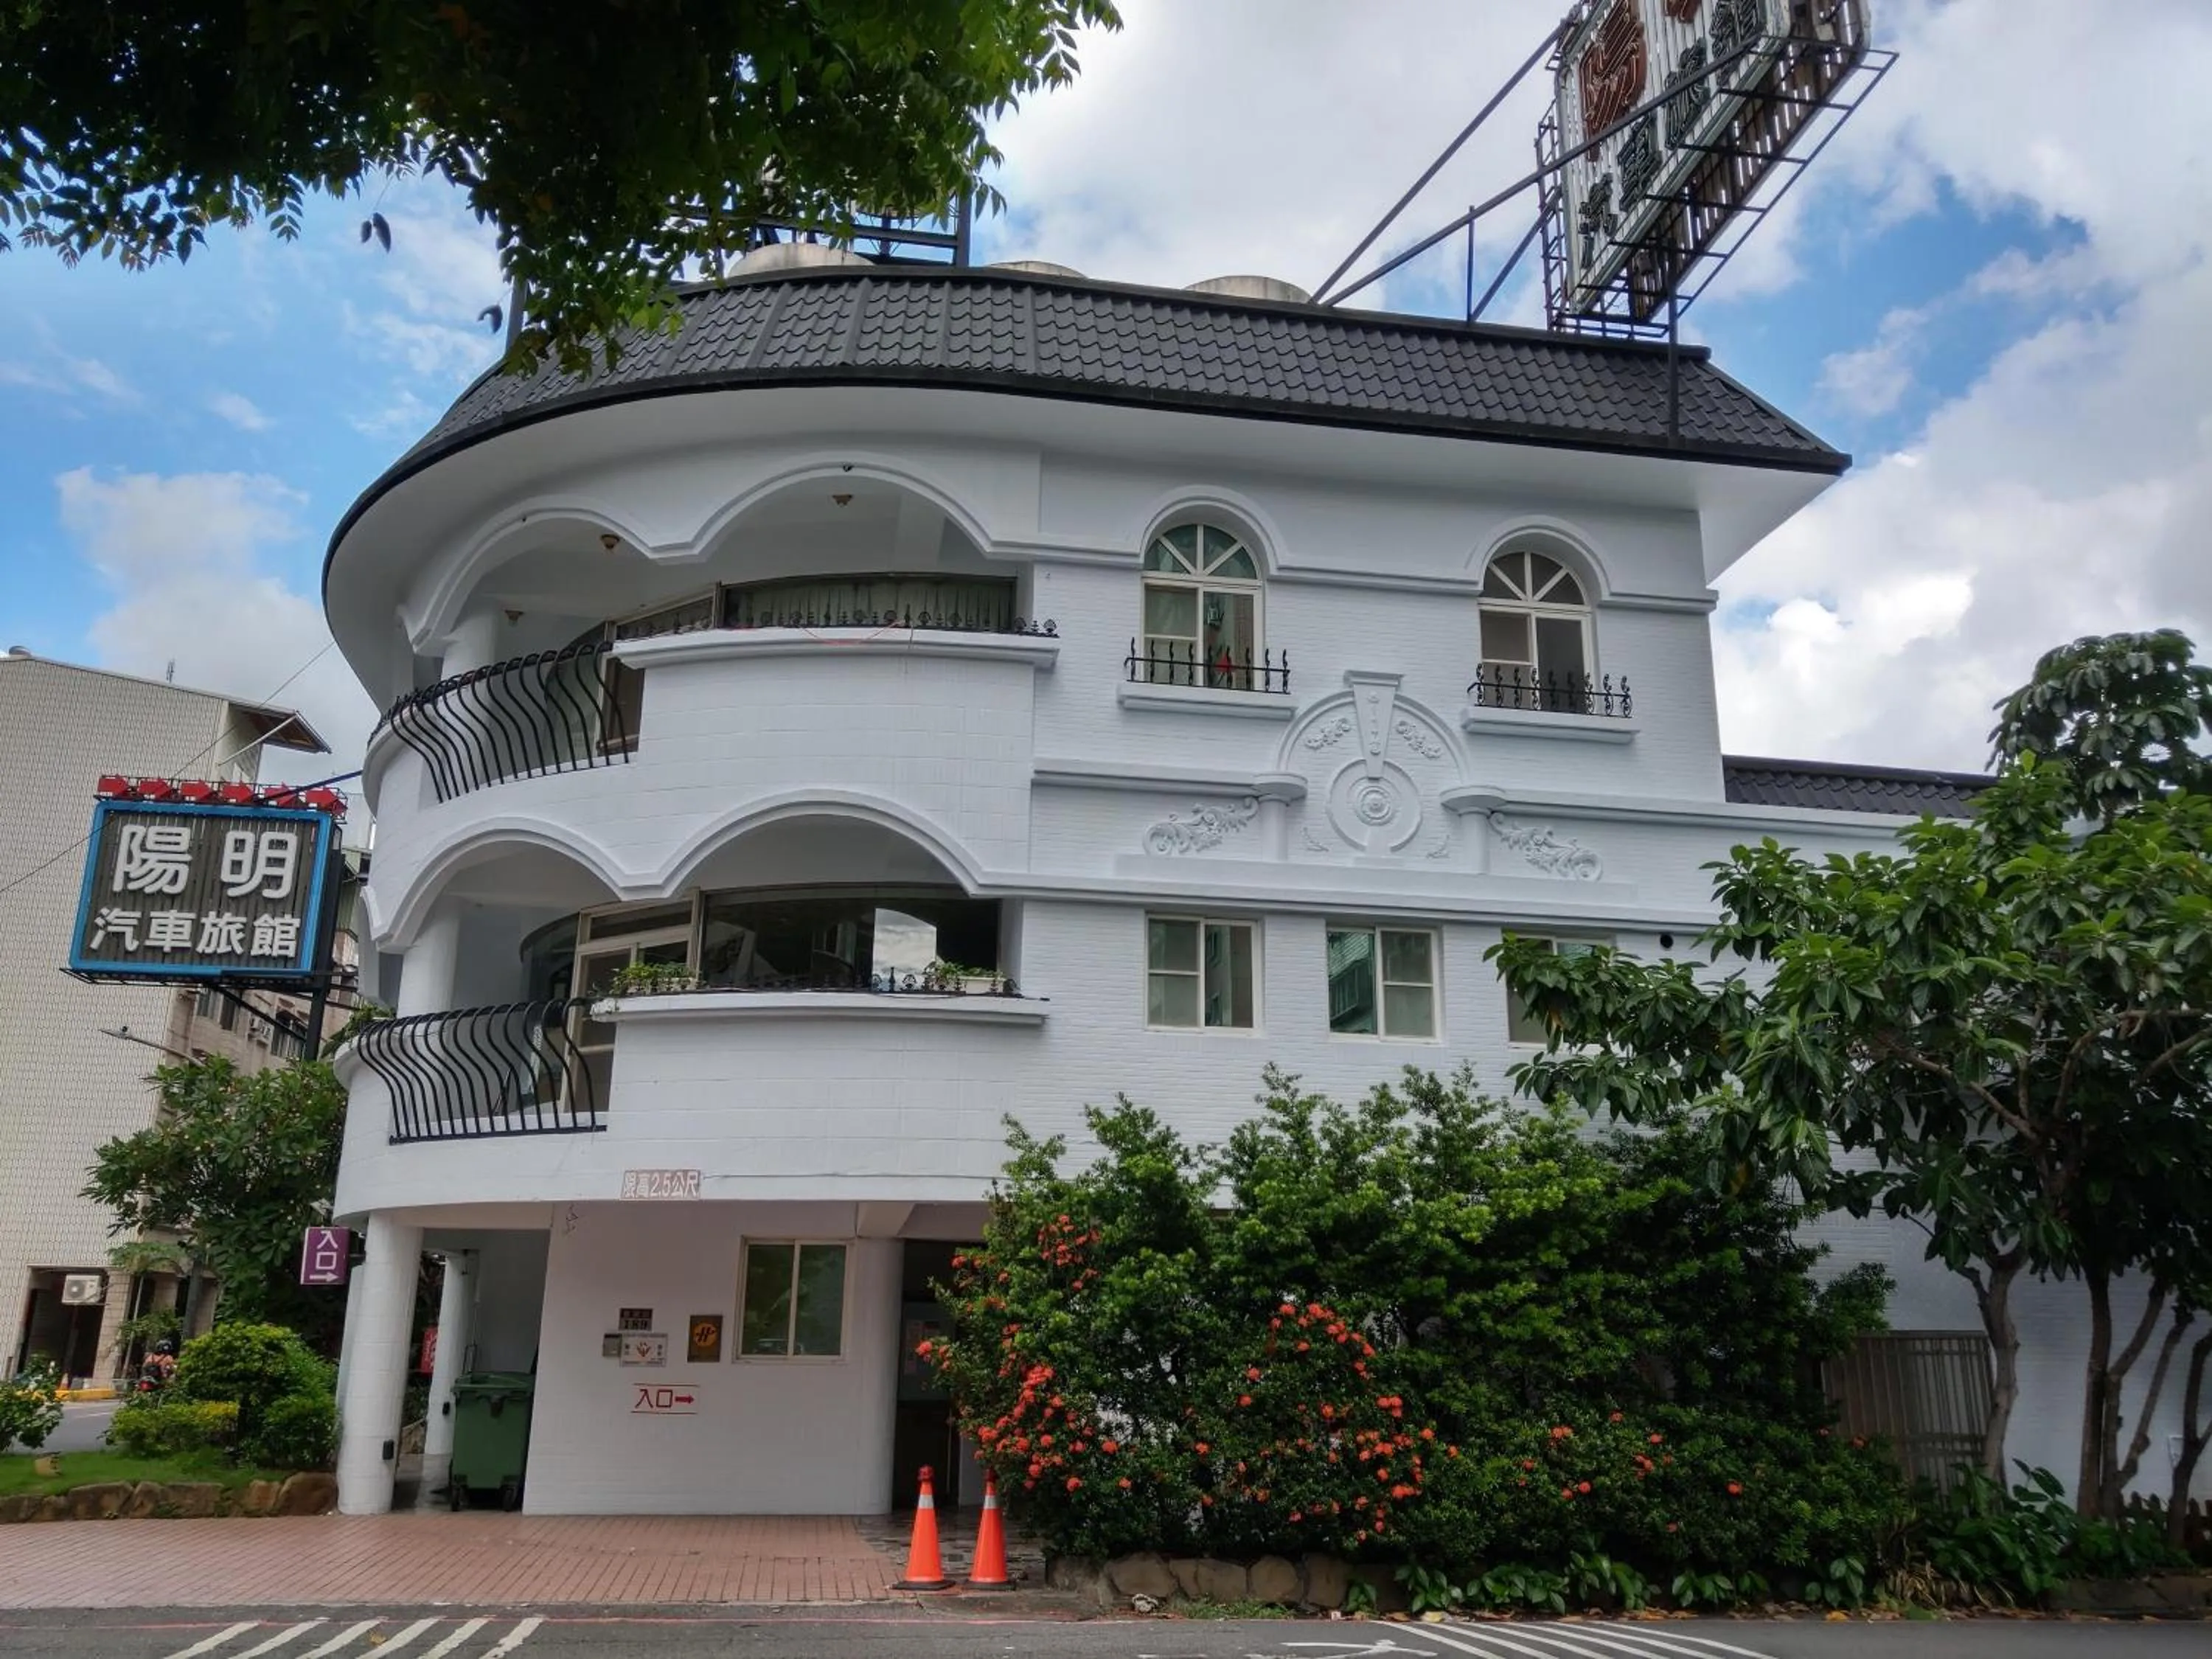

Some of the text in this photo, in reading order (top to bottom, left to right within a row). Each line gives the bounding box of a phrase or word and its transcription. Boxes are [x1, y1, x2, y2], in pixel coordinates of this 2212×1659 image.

[112, 824, 298, 899] 陽明
[90, 908, 301, 958] 汽車旅館
[315, 1230, 338, 1270] 入口
[635, 1388, 673, 1409] 入口
